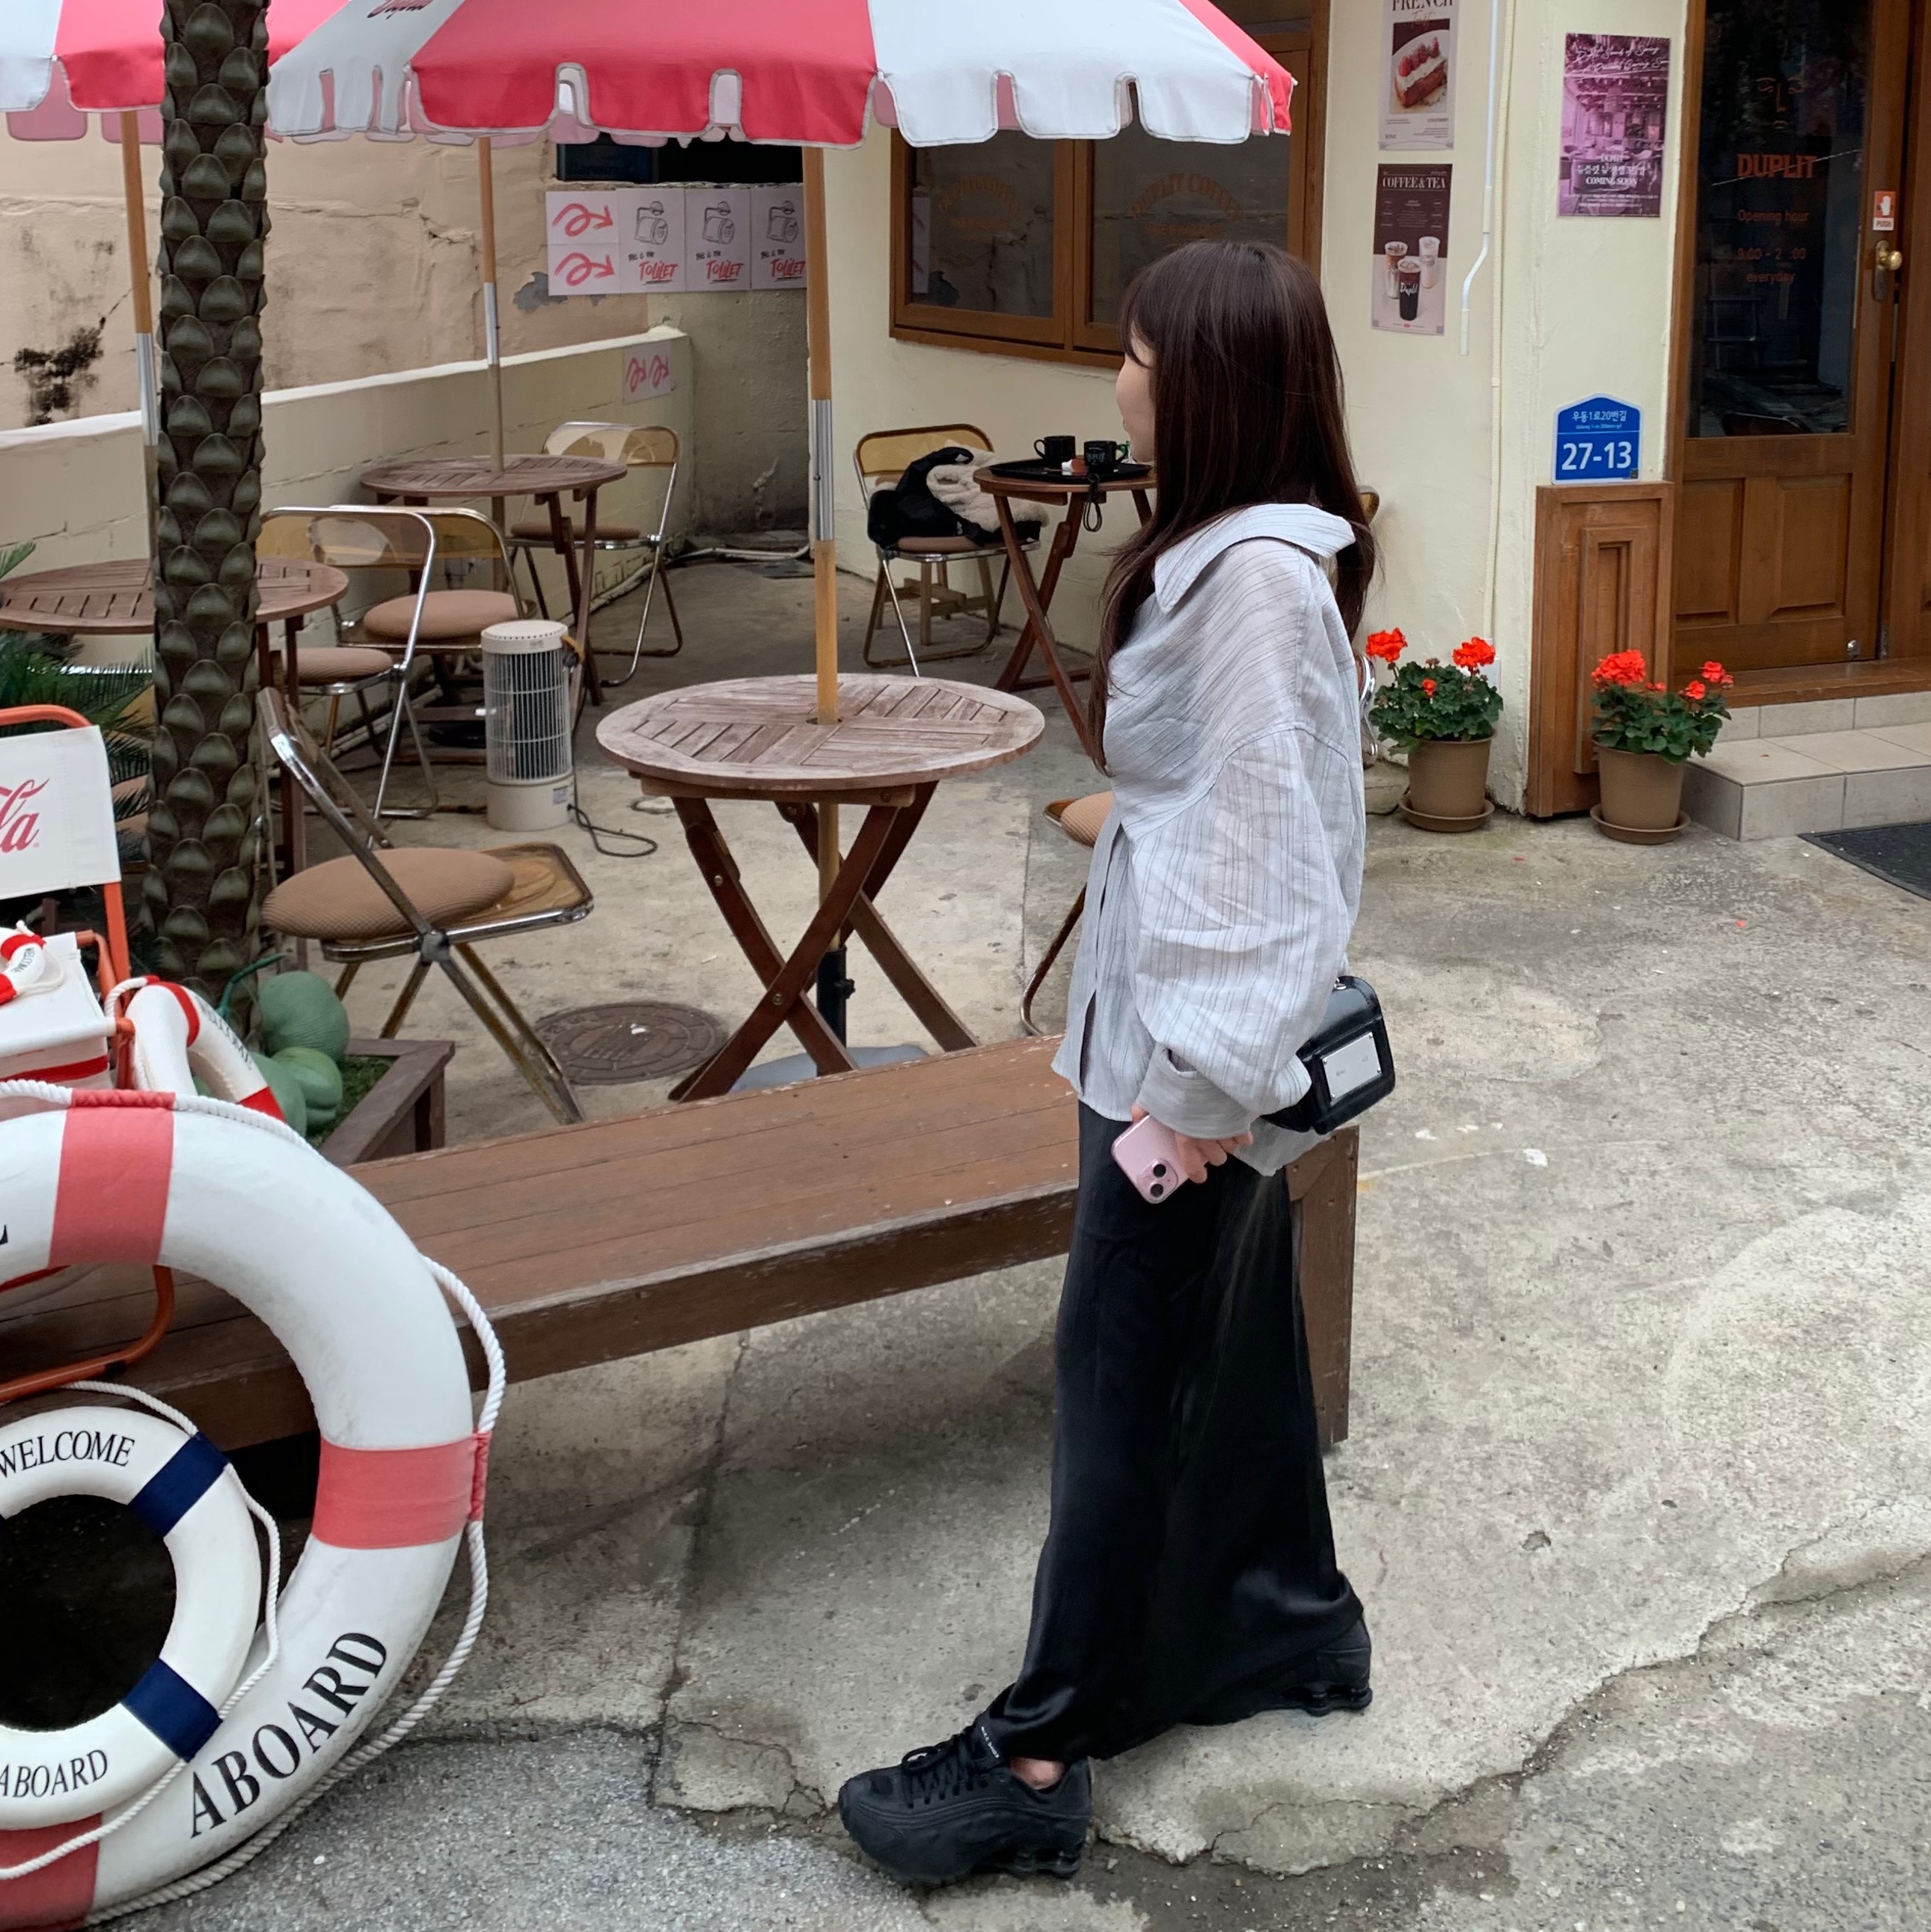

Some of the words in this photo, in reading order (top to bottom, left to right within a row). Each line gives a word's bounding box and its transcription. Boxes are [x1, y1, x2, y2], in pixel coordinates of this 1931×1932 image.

[1736, 153, 1818, 179] DUPLIT
[1737, 210, 1782, 227] Opening
[1572, 409, 1627, 424] 우동1로20번길
[1561, 441, 1632, 471] 27-13
[0, 777, 50, 853] la
[0, 1430, 135, 1479] WELCOME
[190, 1632, 387, 1838] ABOARD
[0, 1749, 108, 1798] ABOARD
